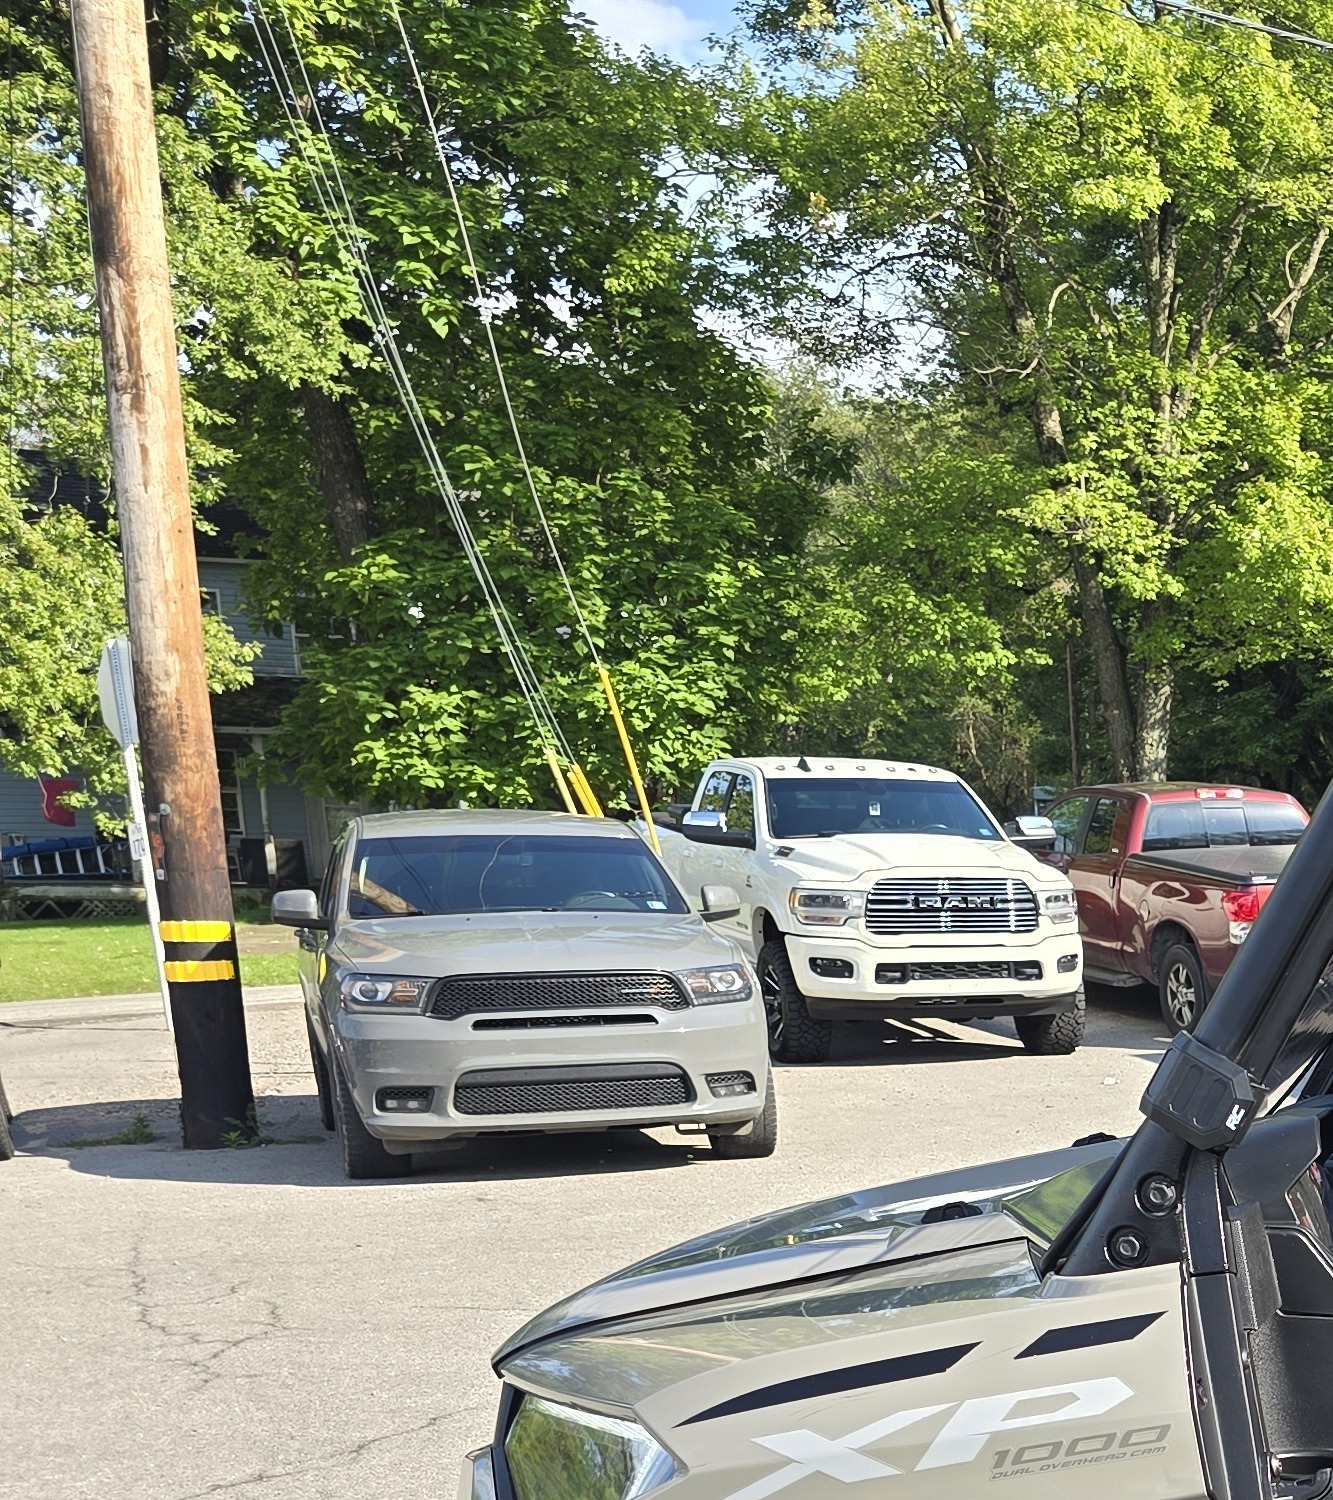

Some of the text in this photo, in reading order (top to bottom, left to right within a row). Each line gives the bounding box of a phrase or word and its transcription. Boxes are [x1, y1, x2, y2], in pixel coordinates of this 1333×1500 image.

[991, 1445, 1168, 1480] DUAL OVERHEAD CAM
[992, 1423, 1172, 1470] 1000
